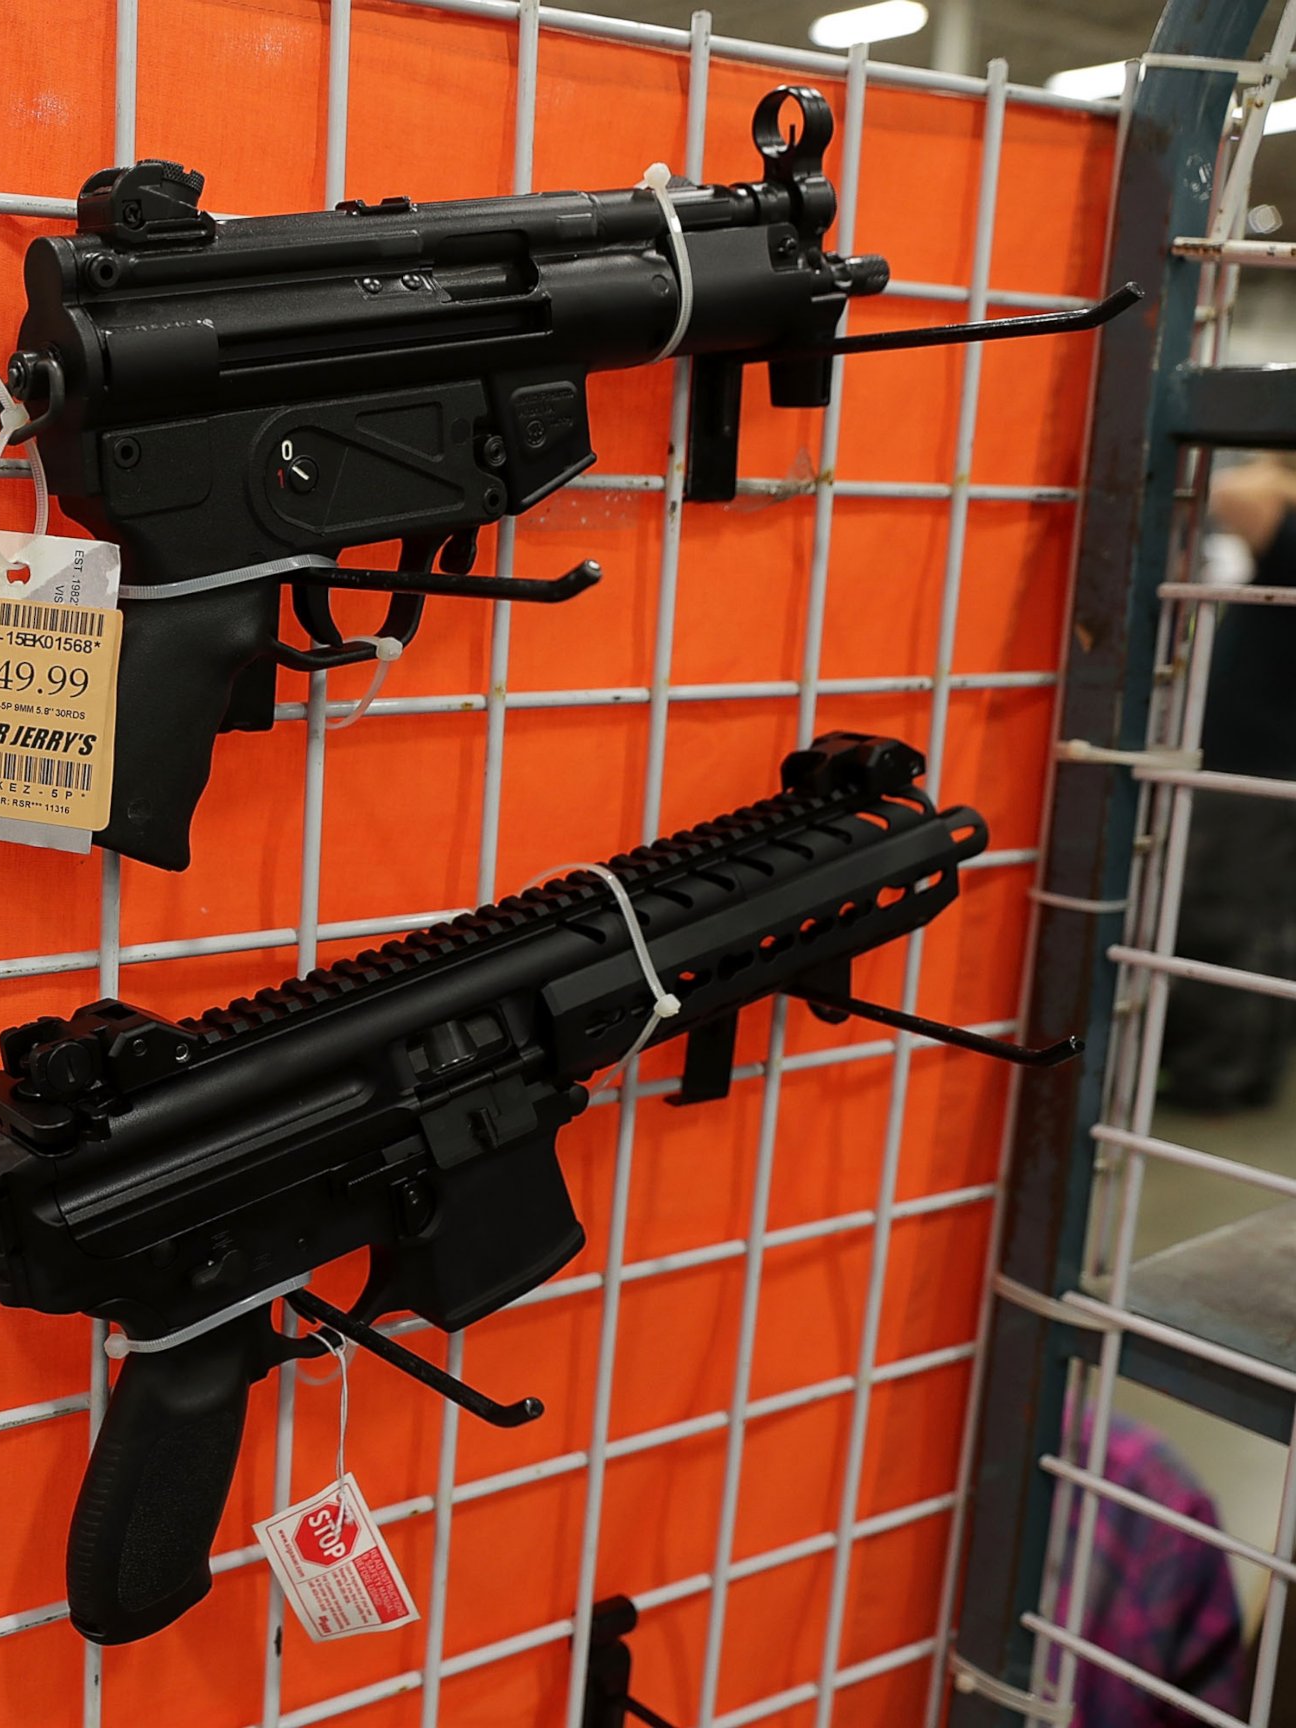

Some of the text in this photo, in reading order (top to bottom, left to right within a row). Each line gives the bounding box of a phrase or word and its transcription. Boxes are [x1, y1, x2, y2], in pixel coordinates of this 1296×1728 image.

[74, 550, 85, 572] EST
[14, 703, 34, 713] 9MM
[55, 708, 86, 720] 30RDS
[9, 725, 97, 756] JERRY'S
[45, 803, 70, 814] 11316
[308, 1510, 346, 1558] STOP
